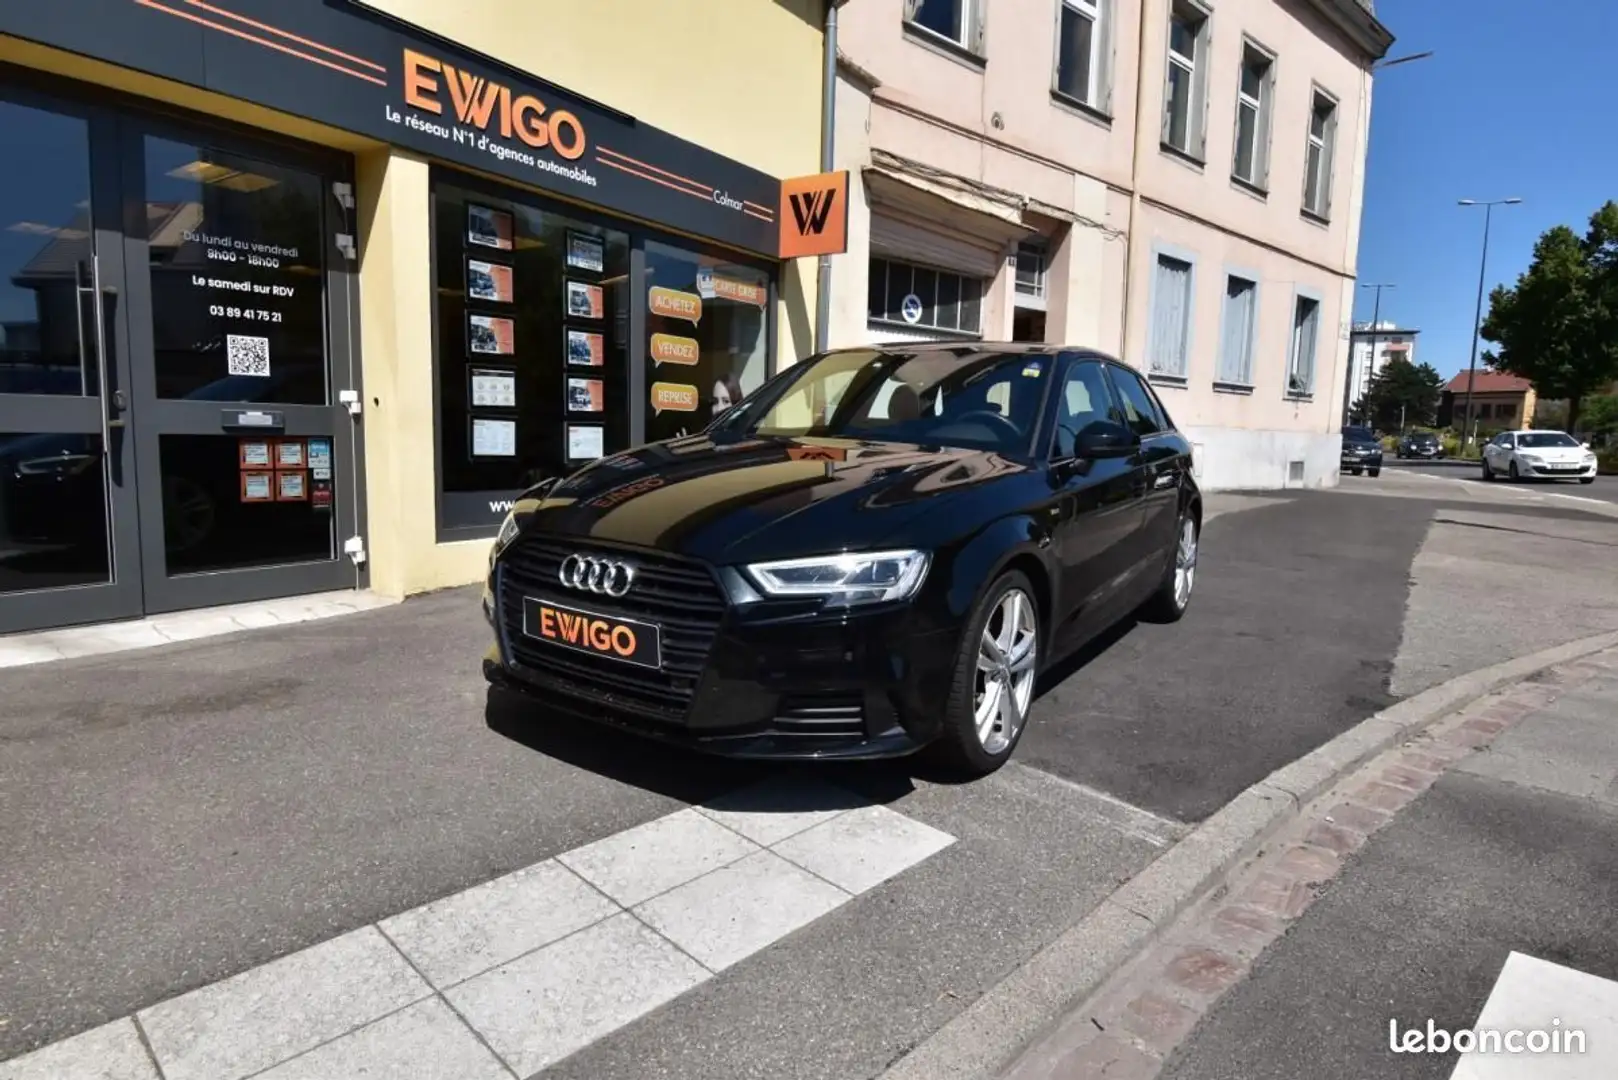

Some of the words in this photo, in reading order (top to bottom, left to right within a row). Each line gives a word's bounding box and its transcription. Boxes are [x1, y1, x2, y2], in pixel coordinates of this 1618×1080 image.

[403, 48, 586, 160] EWIGO
[386, 105, 401, 123] Le
[405, 115, 450, 139] réseau
[537, 158, 598, 187] automobiles
[713, 190, 744, 211] Colmar
[183, 230, 200, 242] Du
[202, 233, 232, 247] lundi
[234, 240, 249, 250] au
[251, 243, 299, 258] vendredi
[247, 254, 280, 268] 18h00
[192, 275, 206, 286] Le
[208, 278, 252, 292] samedi
[253, 283, 272, 294] sur
[272, 285, 295, 297] RDV
[209, 305, 225, 316] 03
[226, 306, 242, 318] 89
[243, 309, 255, 320] 41
[257, 310, 270, 321] 75
[271, 312, 283, 322] 21
[655, 294, 696, 315] ACHETEZ
[657, 340, 694, 359] VENDEZ
[658, 389, 693, 406] REPRISE
[539, 606, 637, 657] EWIGO
